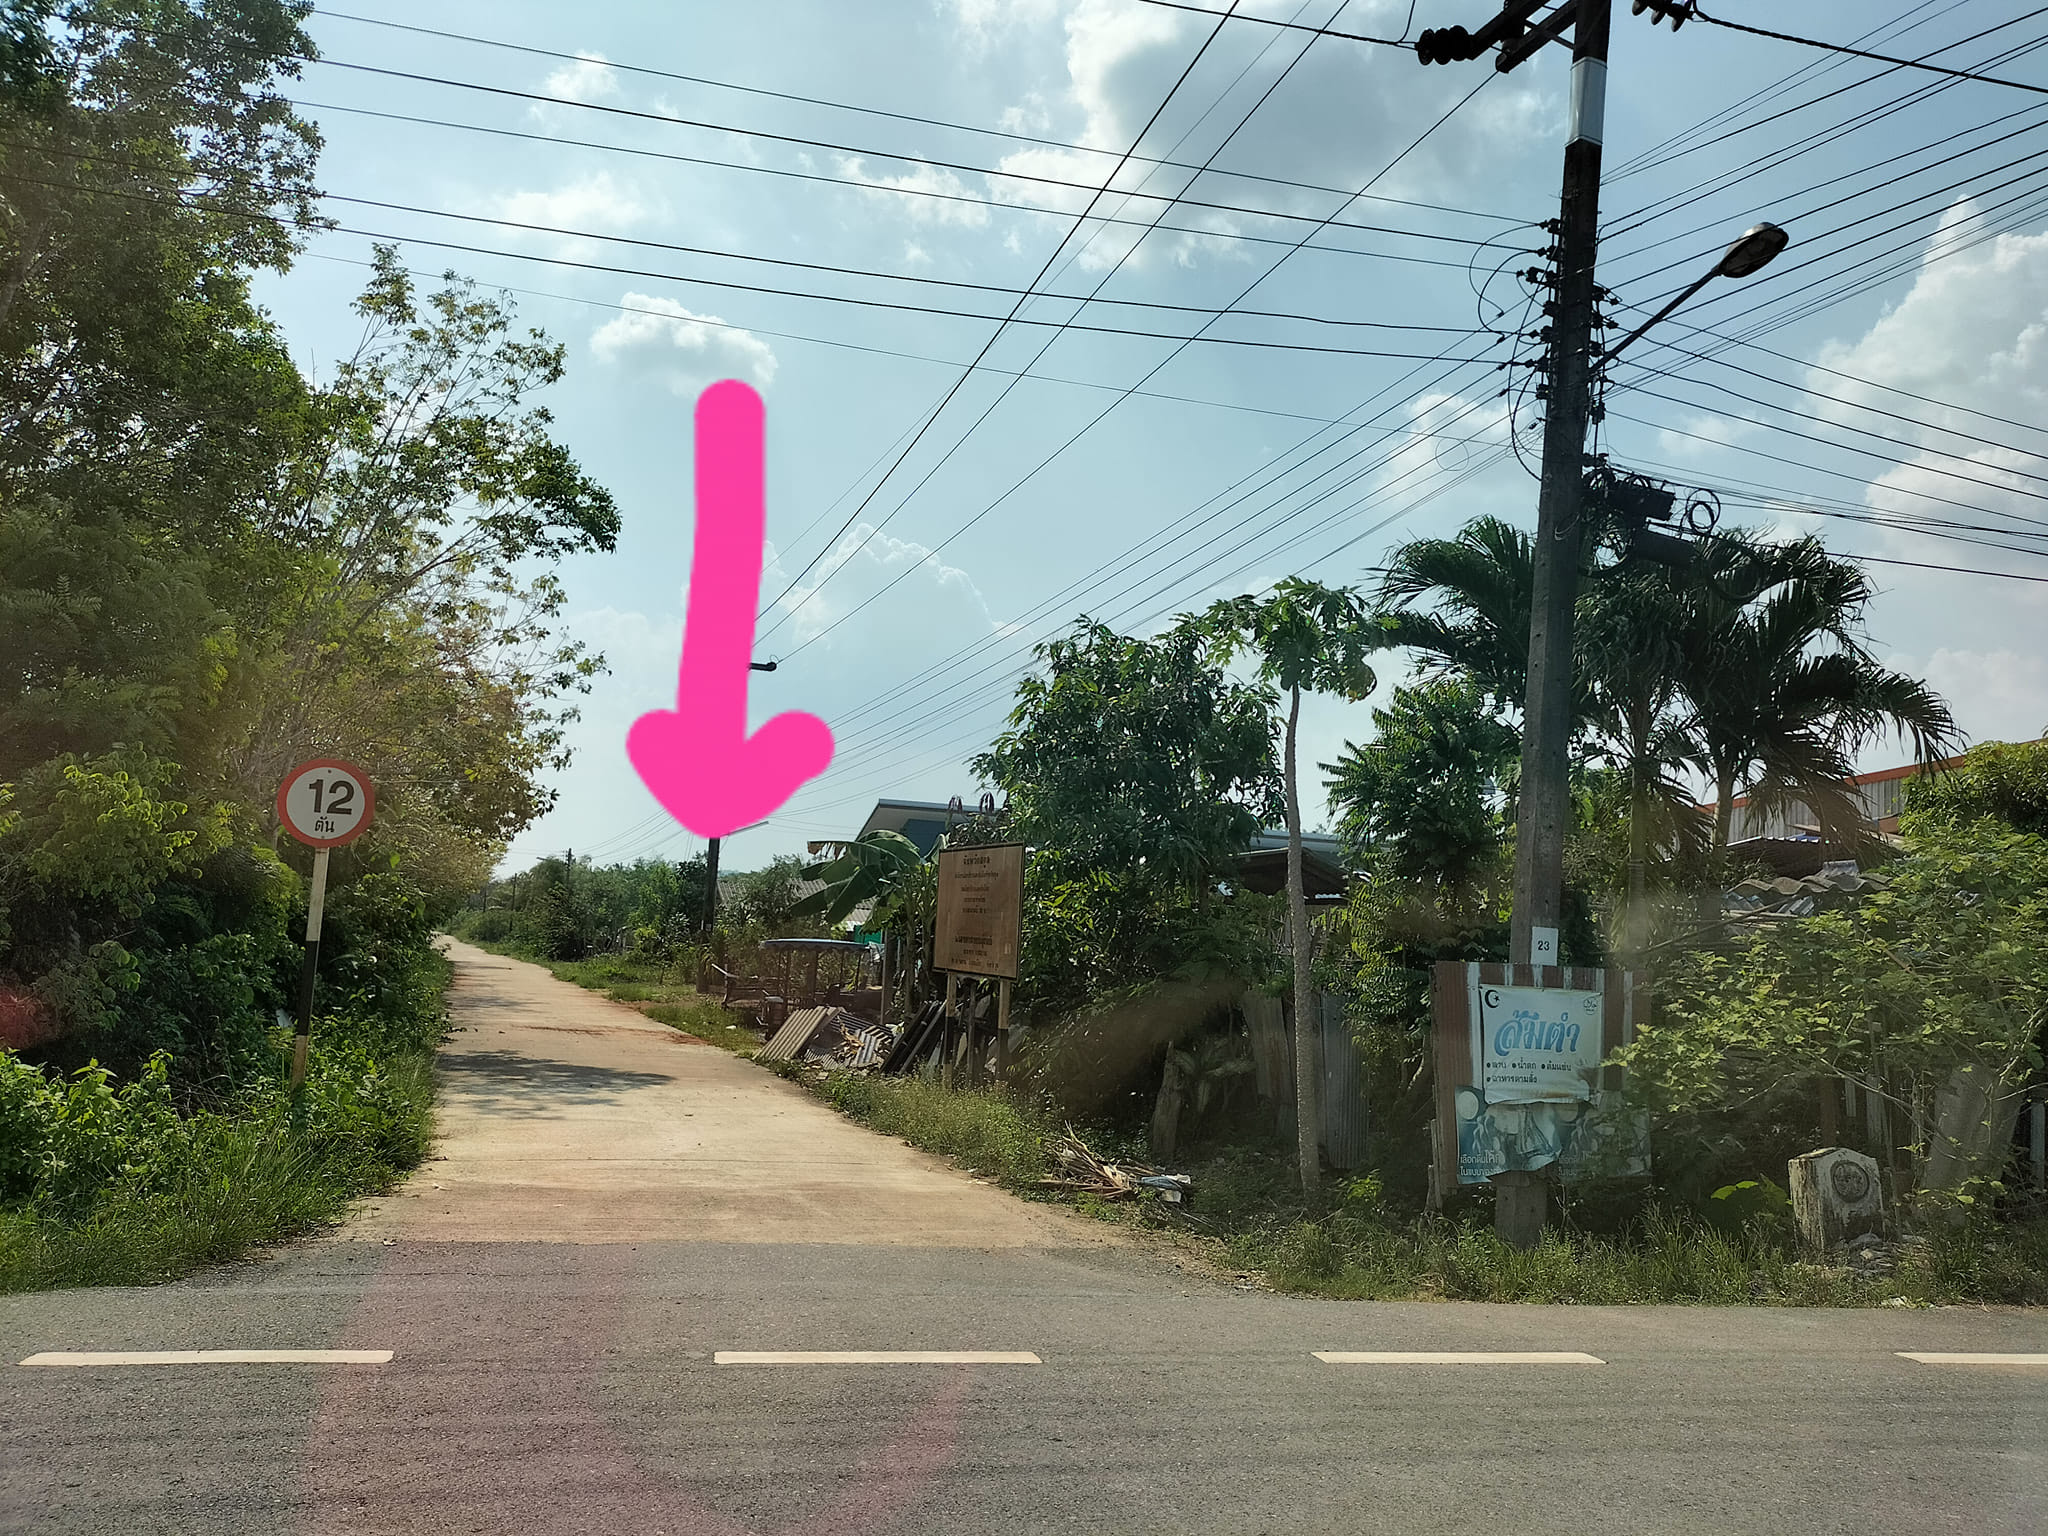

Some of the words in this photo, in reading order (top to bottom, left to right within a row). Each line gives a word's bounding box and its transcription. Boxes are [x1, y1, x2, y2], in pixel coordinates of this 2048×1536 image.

[309, 779, 354, 815] 12
[315, 816, 335, 832] ตัน
[1537, 940, 1550, 951] 23
[1494, 1010, 1581, 1057] ส้มตำ
